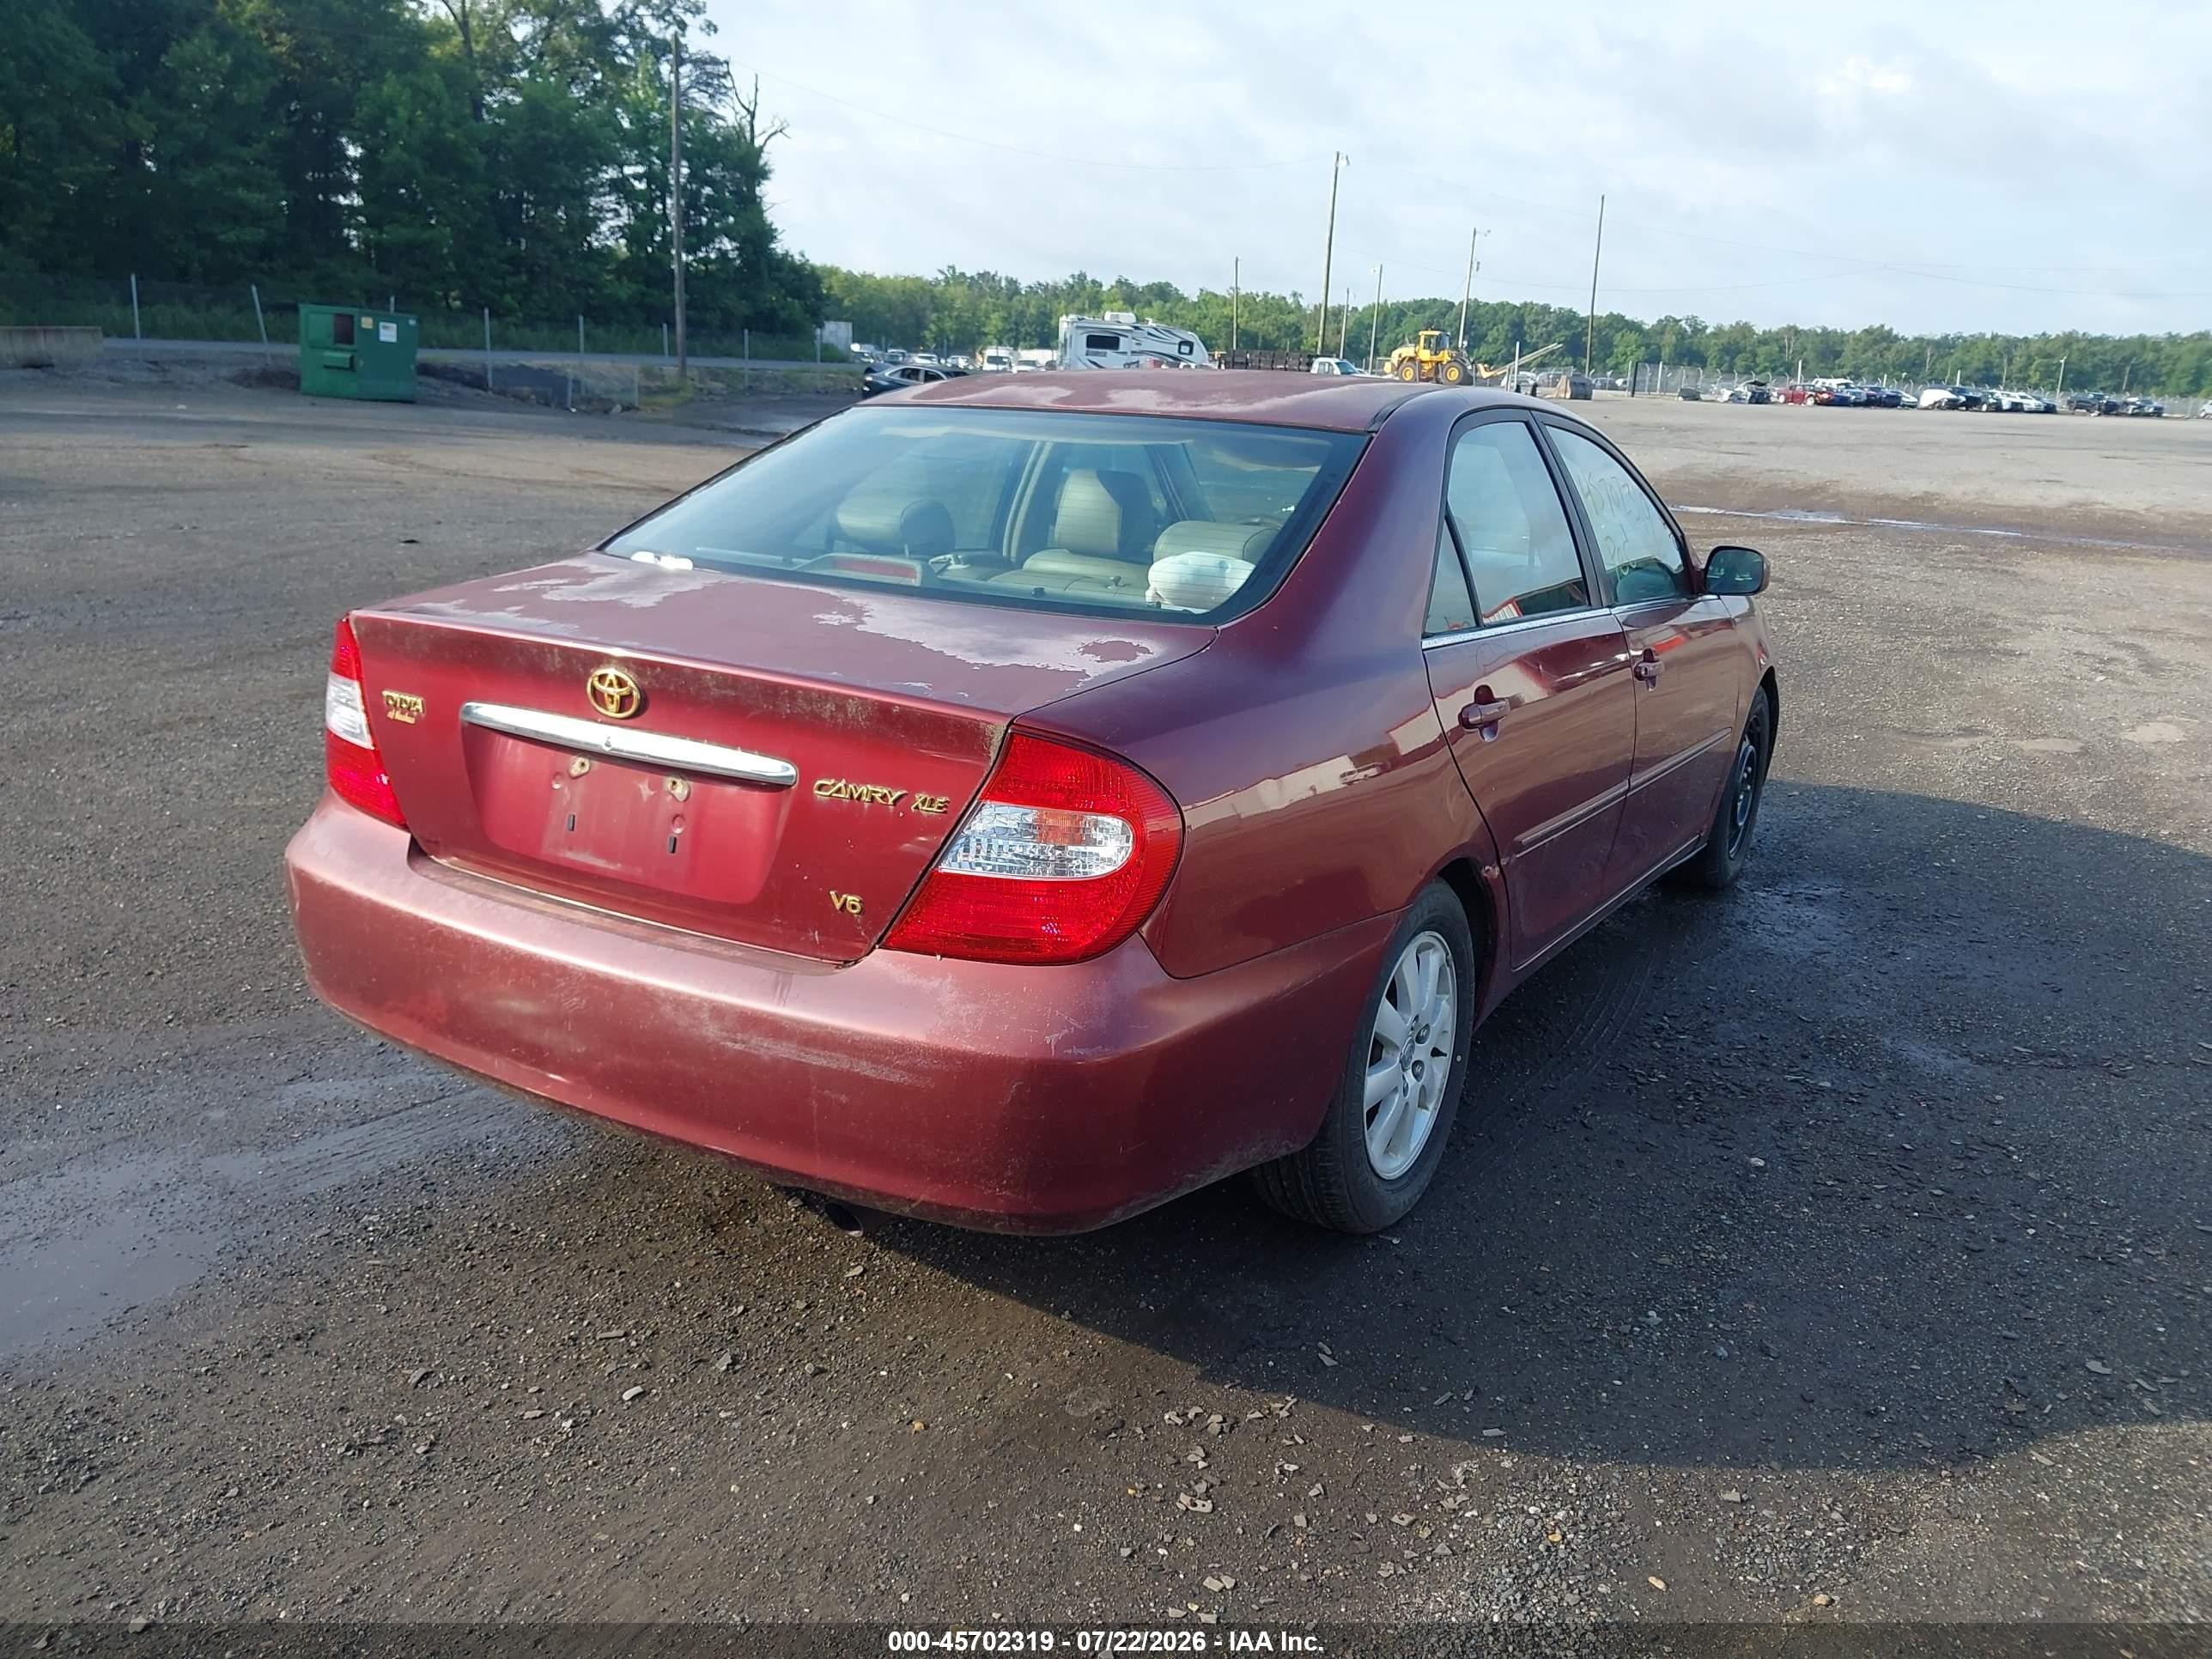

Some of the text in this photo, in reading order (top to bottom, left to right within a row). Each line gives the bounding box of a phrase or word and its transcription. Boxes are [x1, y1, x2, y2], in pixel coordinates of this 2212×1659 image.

[813, 779, 950, 813] CAMRY XLE
[829, 890, 864, 915] V6
